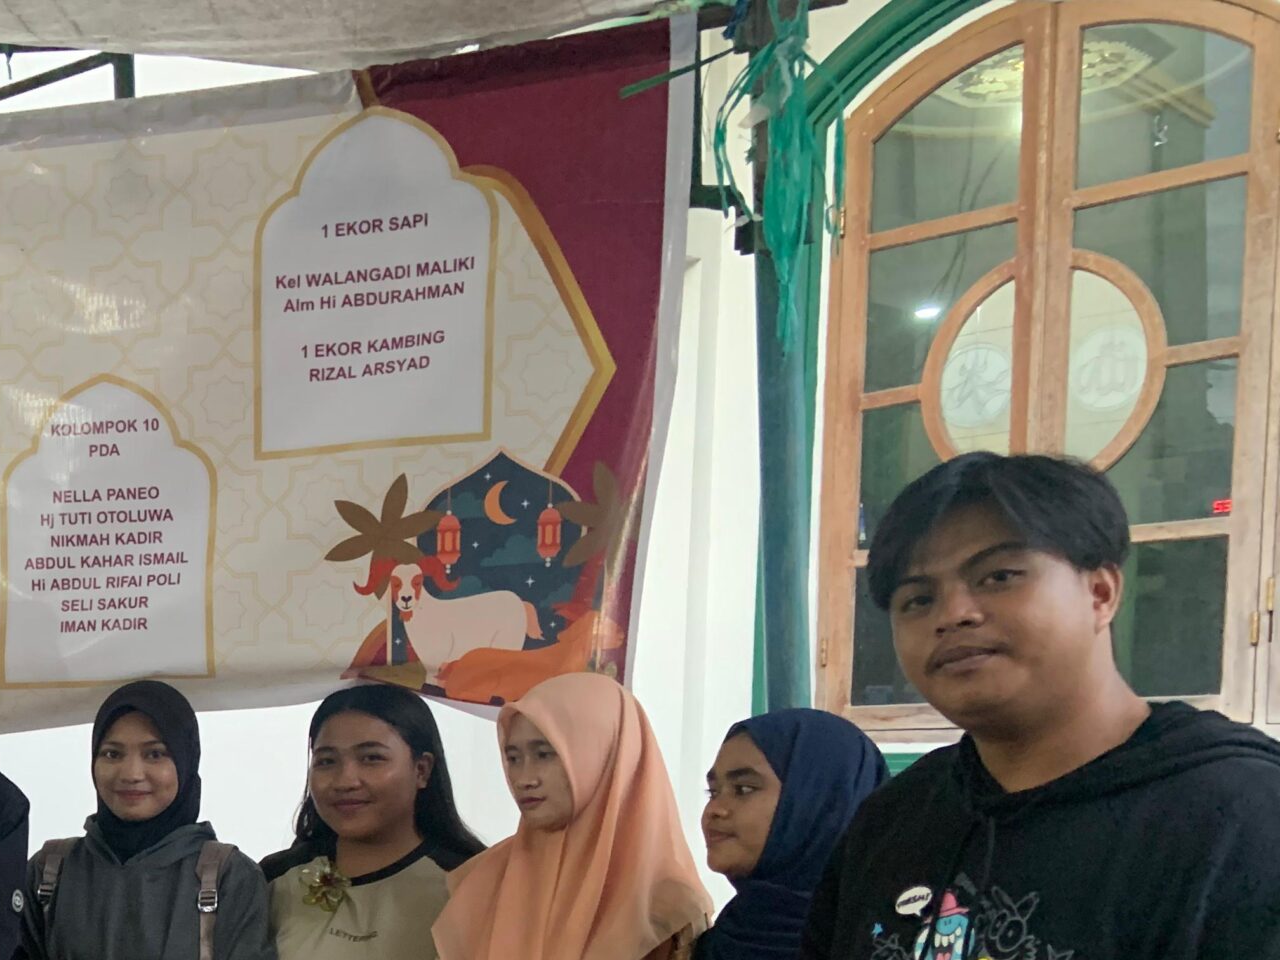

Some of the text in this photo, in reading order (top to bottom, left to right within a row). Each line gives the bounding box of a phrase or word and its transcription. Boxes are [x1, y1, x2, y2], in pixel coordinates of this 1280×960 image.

[321, 213, 428, 238] 1 EKOR SAPI
[276, 257, 475, 289] Kel WALANGADI MALIKI
[283, 282, 465, 312] Alm Hi ABDURAHMAN
[301, 330, 445, 358] 1 EKOR KAMBING
[309, 356, 430, 382] RIZAL ARSYAD
[51, 418, 159, 437] KOLOMPOK 10
[89, 444, 120, 457] PDA
[53, 487, 159, 504] NELLA PANEO
[40, 509, 174, 529] Hj TUTI OTOLUWA
[51, 531, 163, 548] NIKMAH KADIR
[25, 552, 188, 570] ABDUL KAHAR ISMAIL
[32, 573, 180, 591] Hi ABDUL RIFAI POLI
[61, 596, 149, 612] SELI SAKUR
[60, 617, 147, 633] IMAN KADIR
